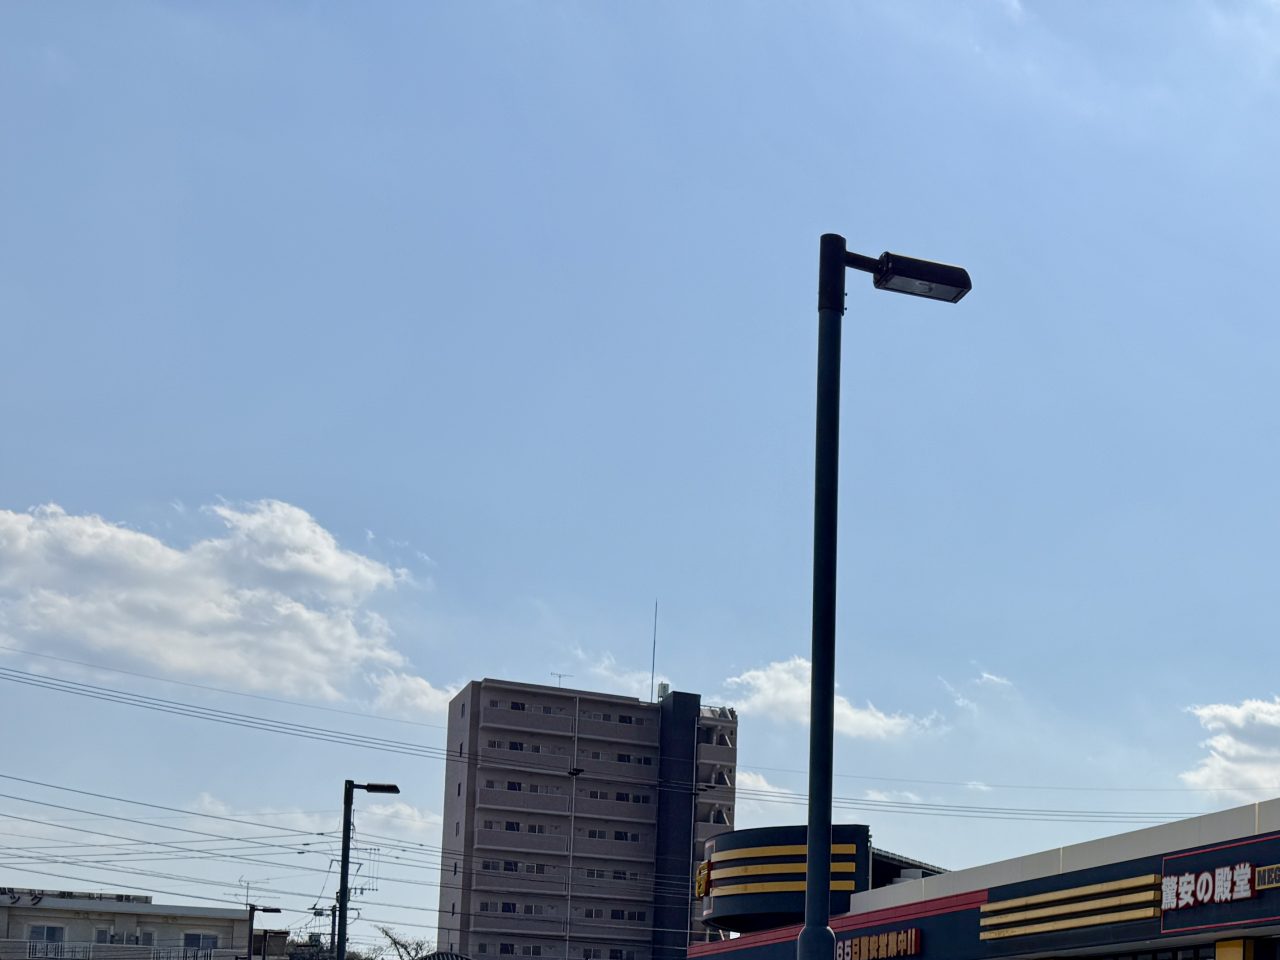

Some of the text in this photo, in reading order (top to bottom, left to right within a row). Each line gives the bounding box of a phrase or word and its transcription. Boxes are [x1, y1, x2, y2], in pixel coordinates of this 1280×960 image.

[1161, 862, 1252, 910] 驚安の殿堂
